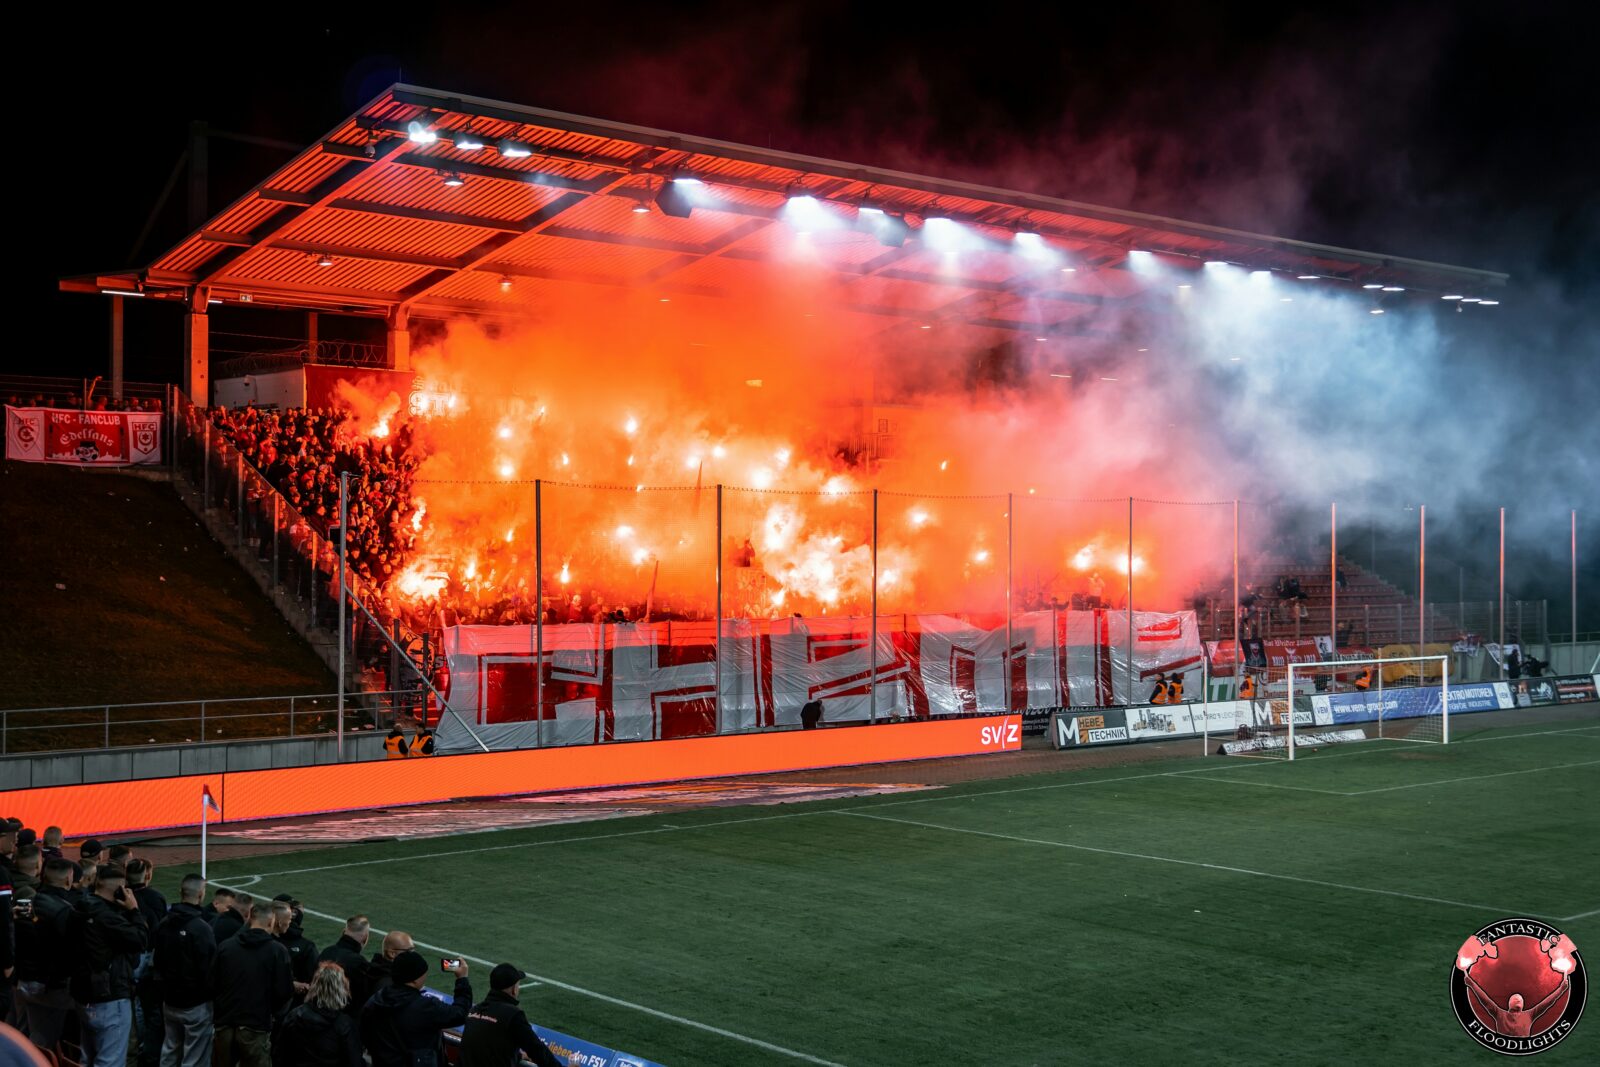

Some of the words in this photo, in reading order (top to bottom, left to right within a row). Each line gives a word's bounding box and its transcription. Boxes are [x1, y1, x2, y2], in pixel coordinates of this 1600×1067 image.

[52, 413, 70, 424] HFC
[79, 414, 120, 425] FANCLUB
[1280, 712, 1312, 723] TEHNIK
[1090, 728, 1126, 741] TECHNIK
[587, 1054, 607, 1067] FSV
